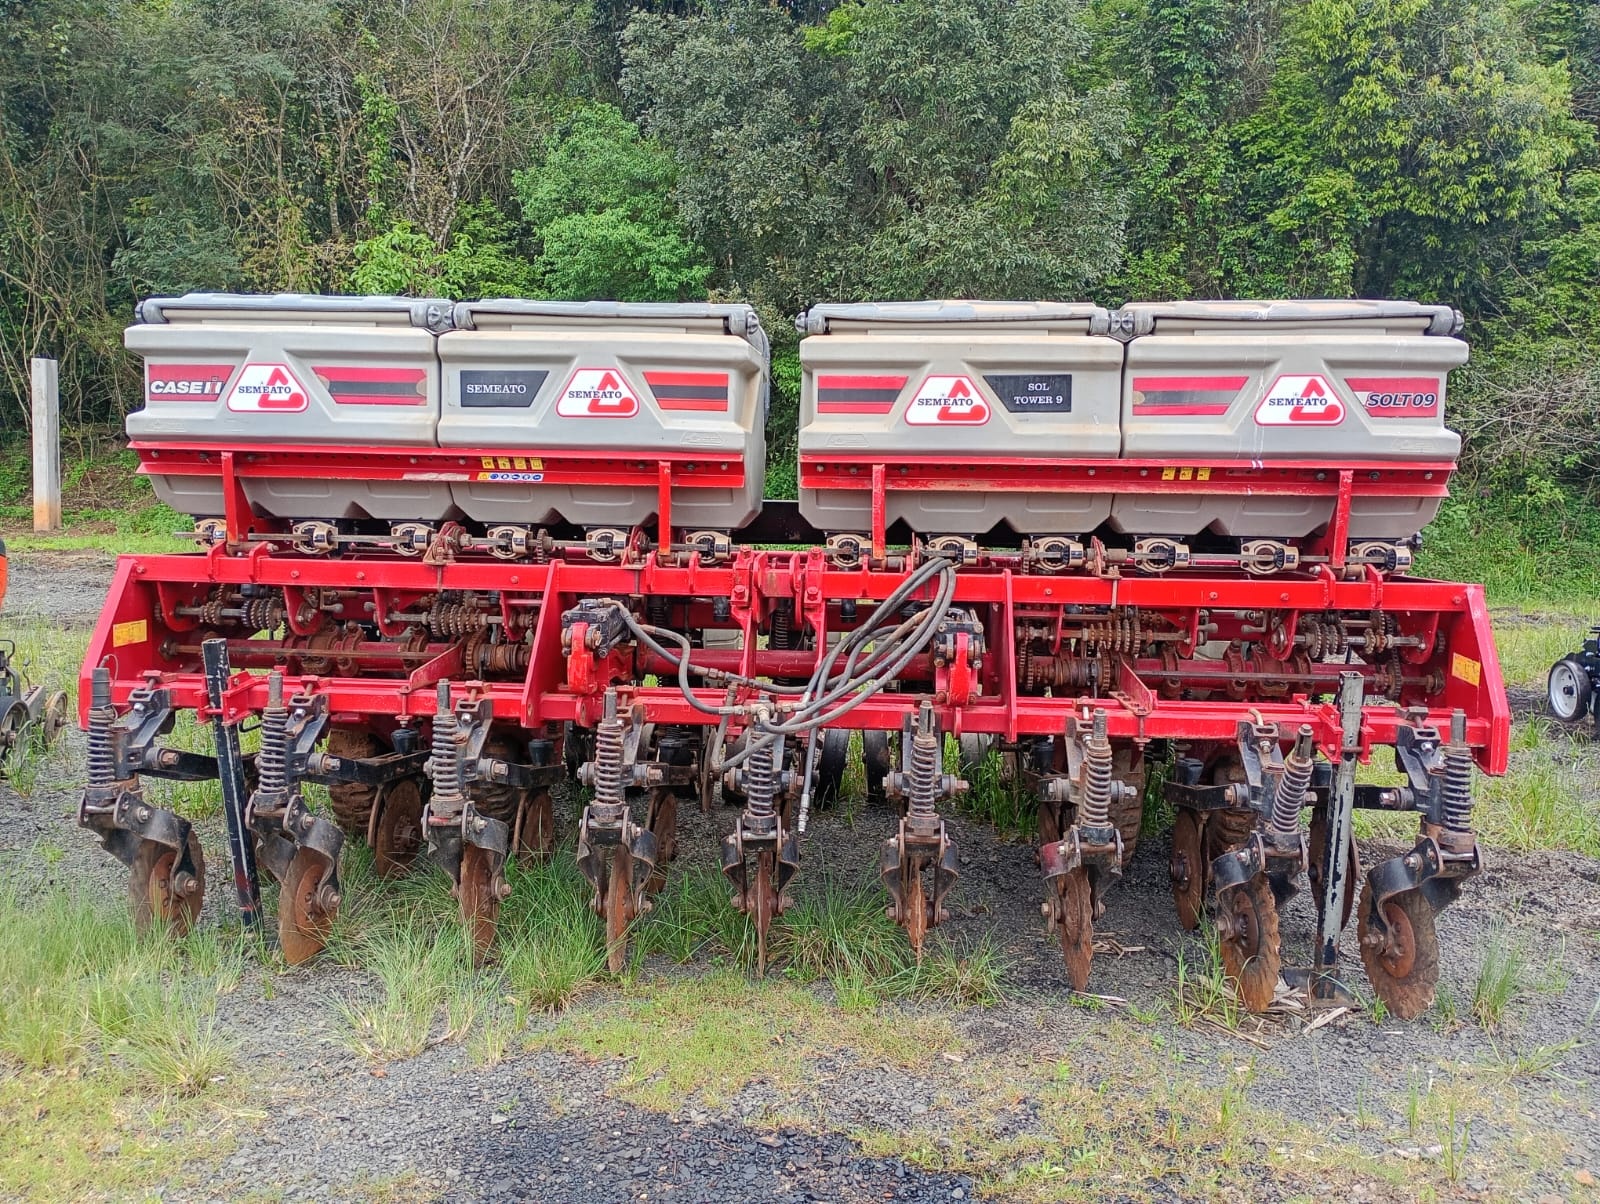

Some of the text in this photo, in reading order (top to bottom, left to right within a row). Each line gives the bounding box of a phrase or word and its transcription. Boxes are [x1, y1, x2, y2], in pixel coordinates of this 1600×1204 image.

[150, 381, 204, 394] CASE
[238, 386, 292, 394] SEMEATO
[466, 384, 527, 394] SEMEATO
[1027, 382, 1050, 391] SOL
[568, 390, 623, 399] SEMEATO
[917, 398, 974, 406] SEMEATO
[1013, 395, 1063, 404] TOWER 9
[1268, 398, 1328, 406] SEMEATO
[1367, 393, 1436, 408] SOLT 09
